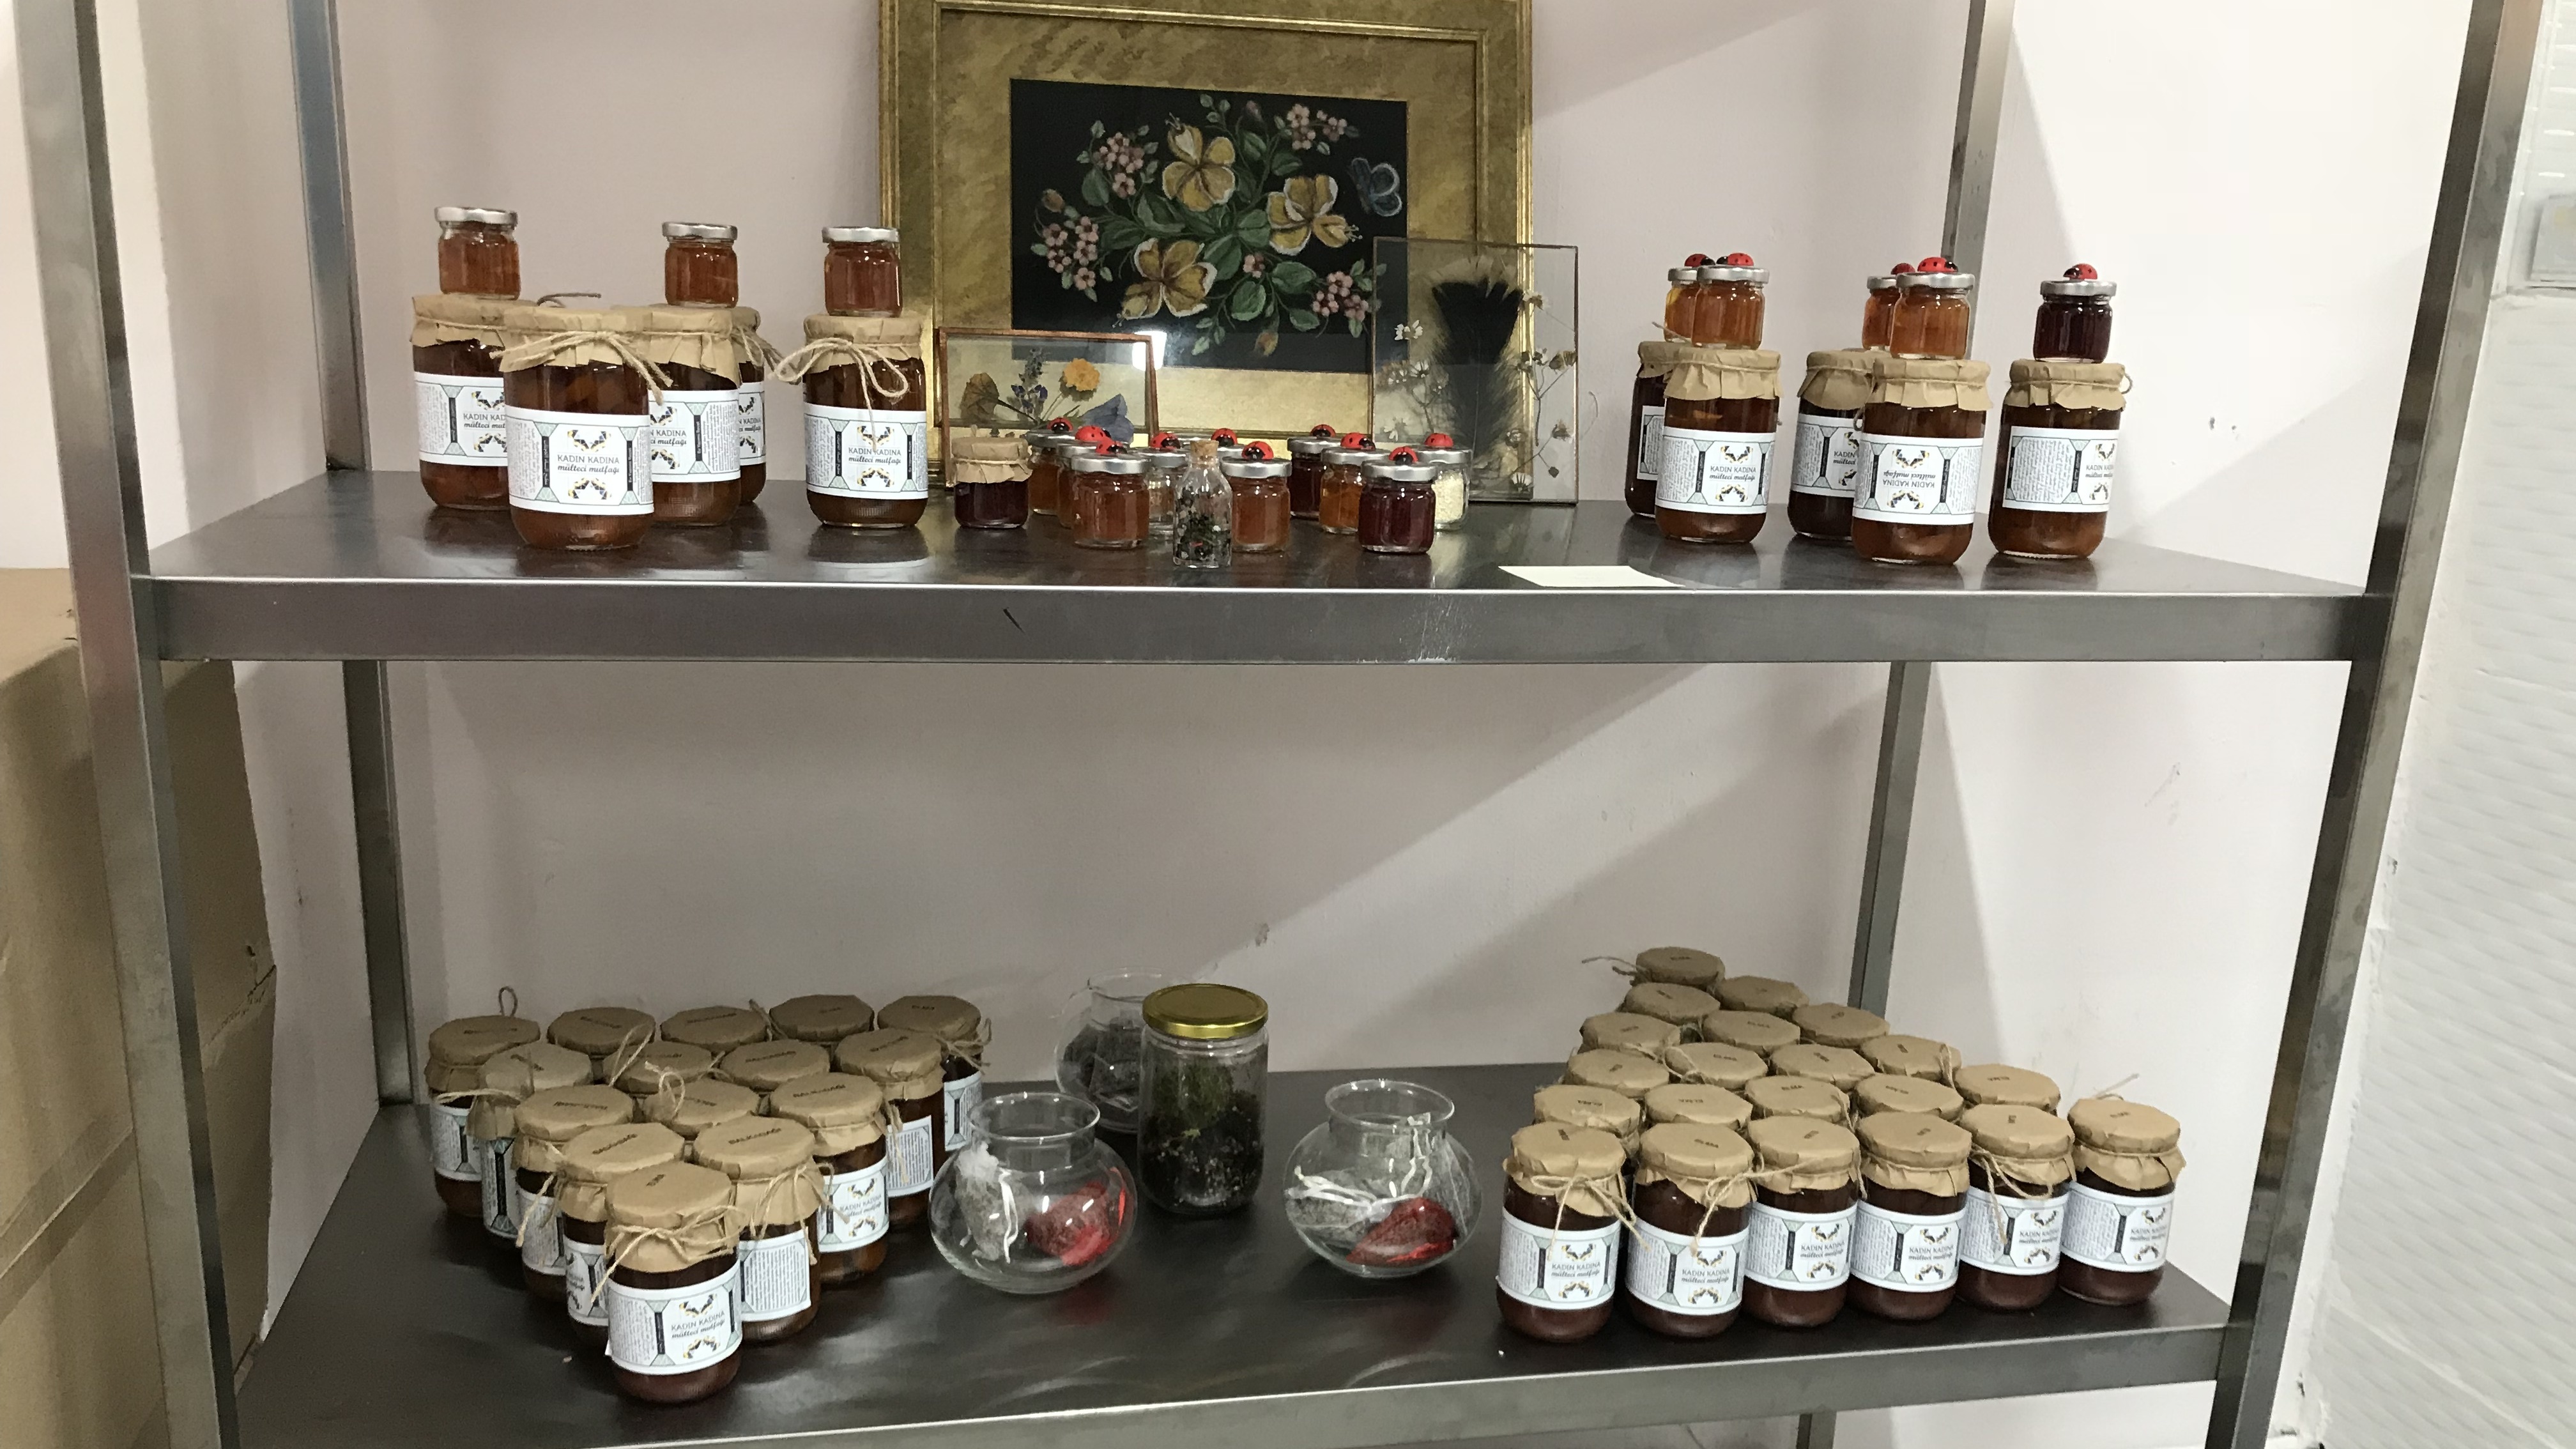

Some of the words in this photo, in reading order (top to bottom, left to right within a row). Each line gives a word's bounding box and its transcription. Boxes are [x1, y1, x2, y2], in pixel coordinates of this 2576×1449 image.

[557, 454, 585, 463] KADIN
[558, 463, 586, 471] mülteci
[1706, 1268, 1730, 1276] KADINA
[671, 1321, 696, 1331] KADIN
[699, 1310, 725, 1325] KADINA
